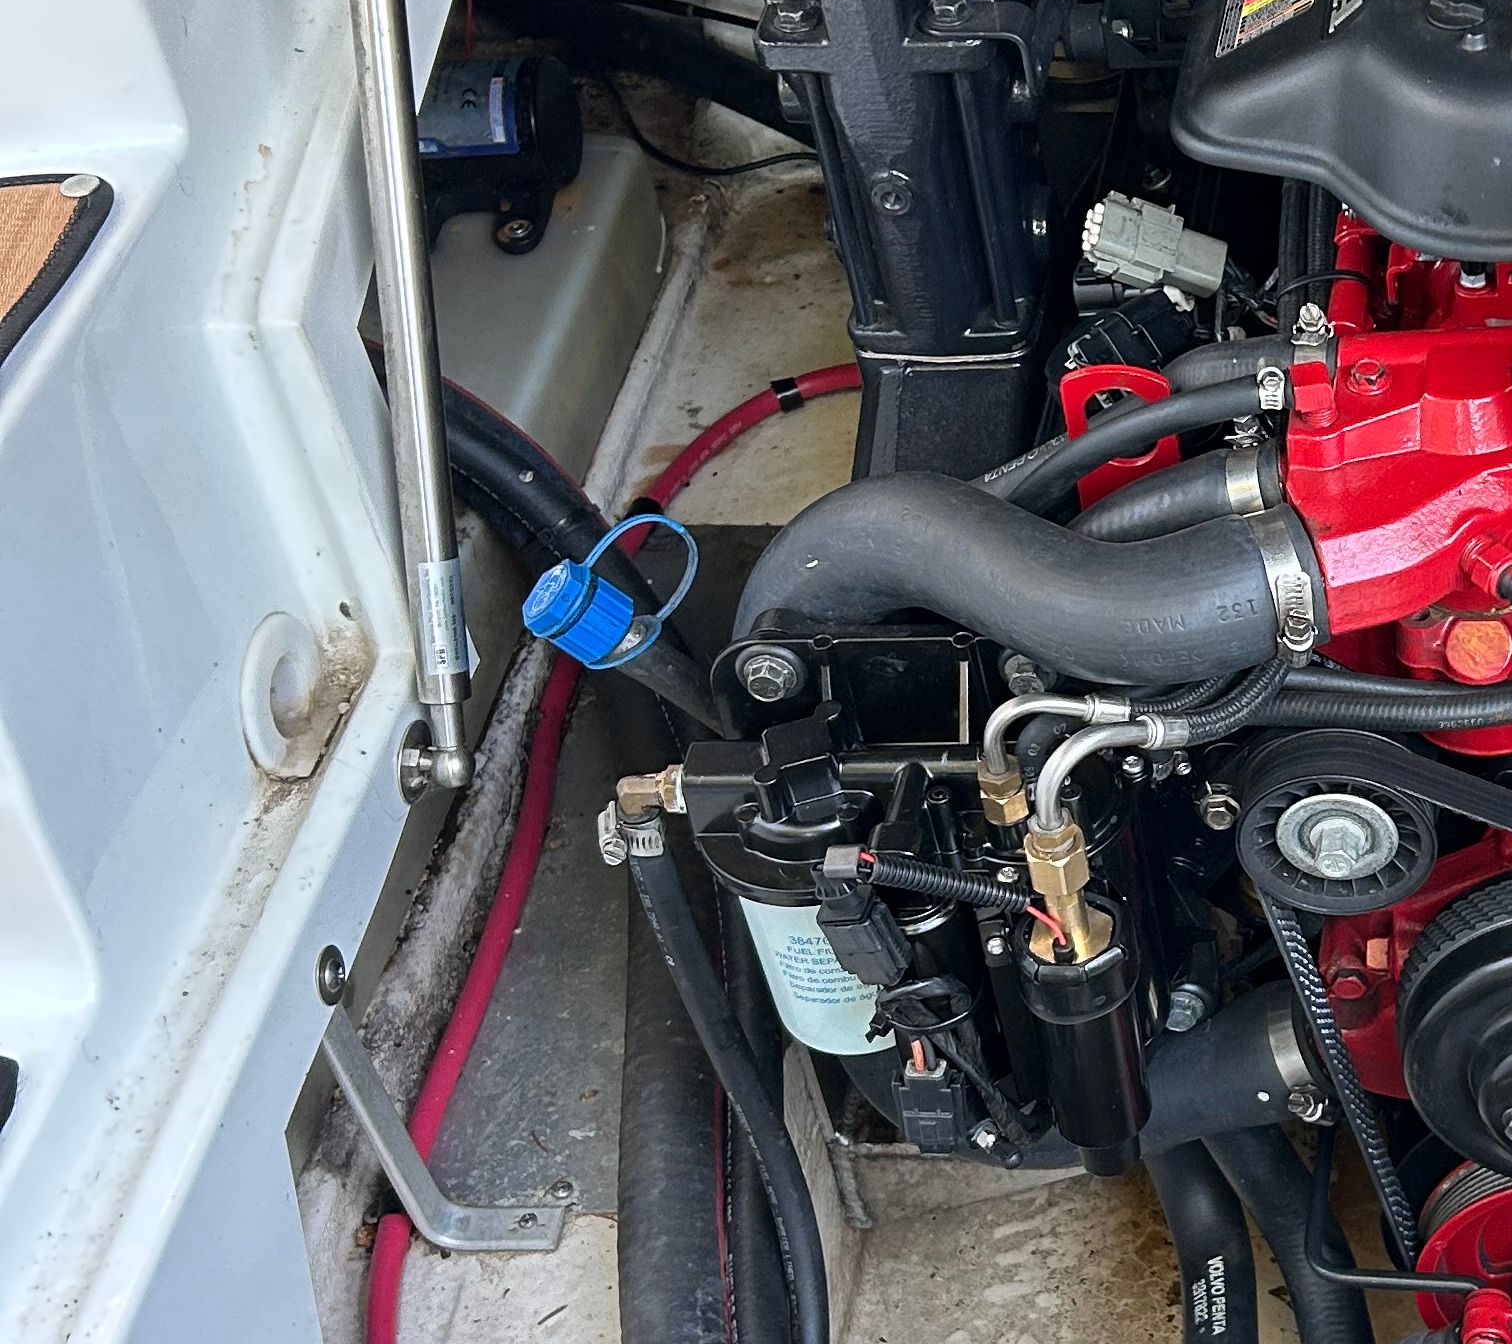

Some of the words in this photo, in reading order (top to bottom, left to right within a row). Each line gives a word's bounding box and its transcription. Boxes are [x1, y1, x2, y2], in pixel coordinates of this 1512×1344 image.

[787, 946, 813, 955] FUEL
[1207, 1256, 1227, 1295] VOLVO
[1208, 1297, 1229, 1335] PENTA
